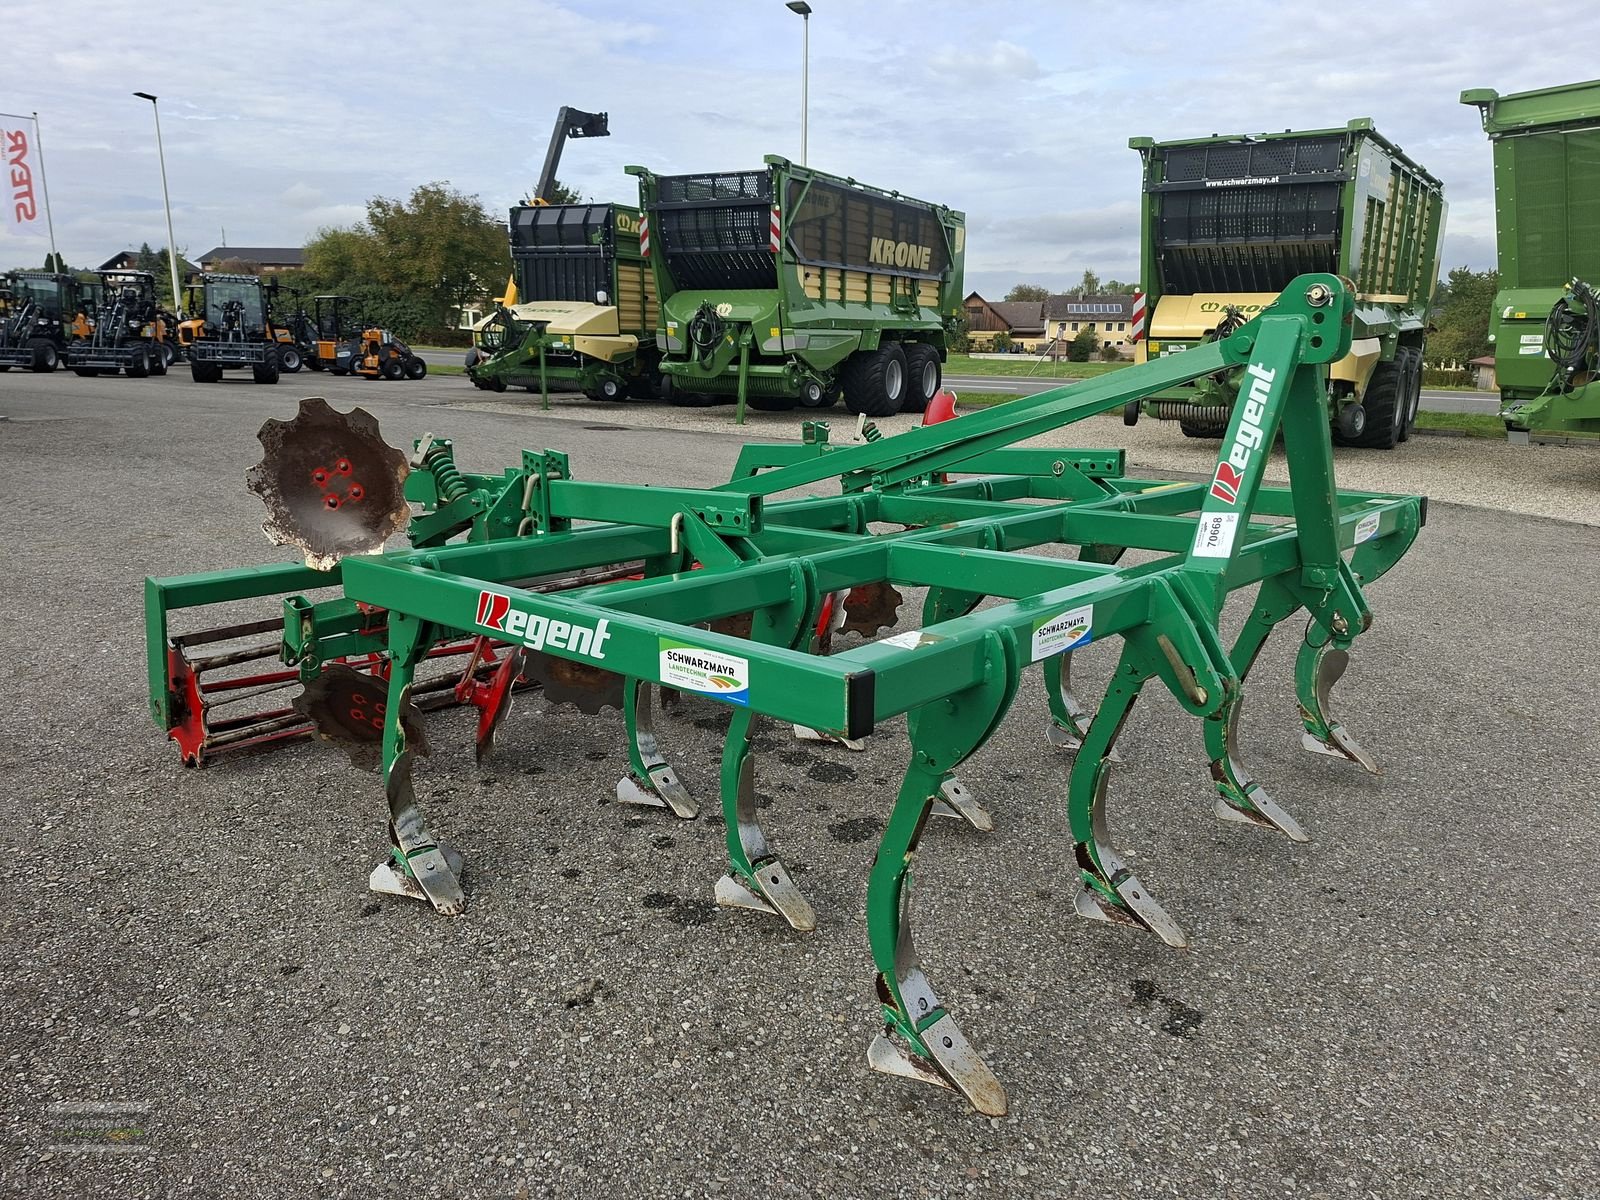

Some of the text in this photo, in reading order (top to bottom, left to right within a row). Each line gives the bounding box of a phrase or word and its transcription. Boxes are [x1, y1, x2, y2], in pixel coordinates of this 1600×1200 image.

[1205, 175, 1279, 187] www.schwarzmayr.at
[869, 236, 932, 271] KRONE
[1210, 362, 1276, 505] Regent
[1207, 517, 1223, 548] 70668
[475, 590, 611, 659] Regent
[1038, 616, 1085, 637] SCHWARZMAYR
[667, 650, 735, 677] SCHWARZMAYR
[668, 663, 707, 678] LANDTECHNIK
